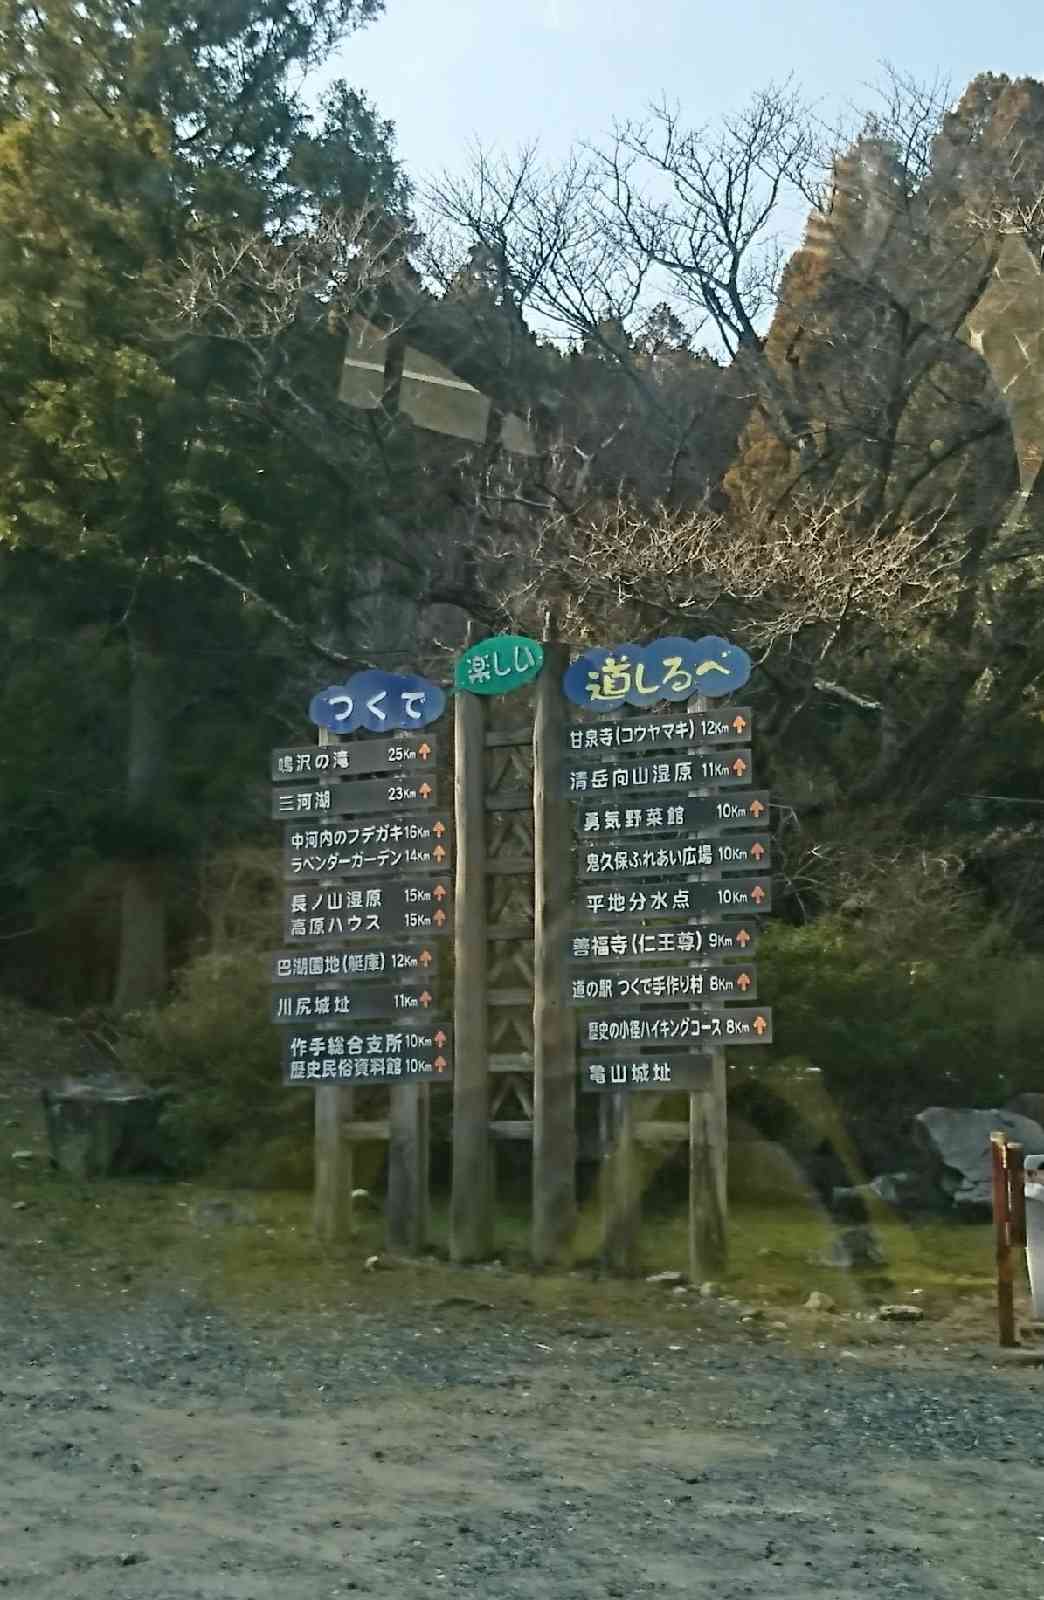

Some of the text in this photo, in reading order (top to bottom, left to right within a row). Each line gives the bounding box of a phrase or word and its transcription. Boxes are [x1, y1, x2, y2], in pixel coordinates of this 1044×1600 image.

[466, 645, 543, 682] 楽しい
[585, 650, 731, 700] 道しるべ
[328, 691, 426, 720] つくで
[569, 719, 730, 749] 甘泉寺(コウヤマキ) 12Km
[278, 747, 416, 773] 鳴沢の滝 25Km
[569, 761, 730, 791] 清岳向山湿原 11Km
[279, 787, 416, 812] 三河湖 23Km
[584, 803, 746, 831] 勇気野菜館 10Km
[291, 824, 430, 849] 中河内のフデガキ 16Km
[291, 849, 430, 873] ラベンダーガーデン 14Km
[586, 844, 748, 873] 鬼久保ふれあい広場 10Km
[291, 889, 431, 913] 長ノ山湿原 15Km
[586, 889, 748, 914] 平地分水点 10Km
[290, 914, 431, 936] 高原ハウス 15Km
[573, 930, 733, 957] 善福寺(仁王尊) 9Km
[391, 953, 418, 969] 12Km
[572, 974, 734, 999] 道の駅 つくで手作り村 8Km
[278, 994, 419, 1017] 川尻城址 11Km
[588, 1016, 750, 1042] 歴史の小径ハイキングコース 8Km
[290, 1032, 432, 1057] 作手総合支所 10Km
[290, 1057, 432, 1081] 歴史民俗資料館 10Km
[588, 1062, 671, 1084] 亀山城址
